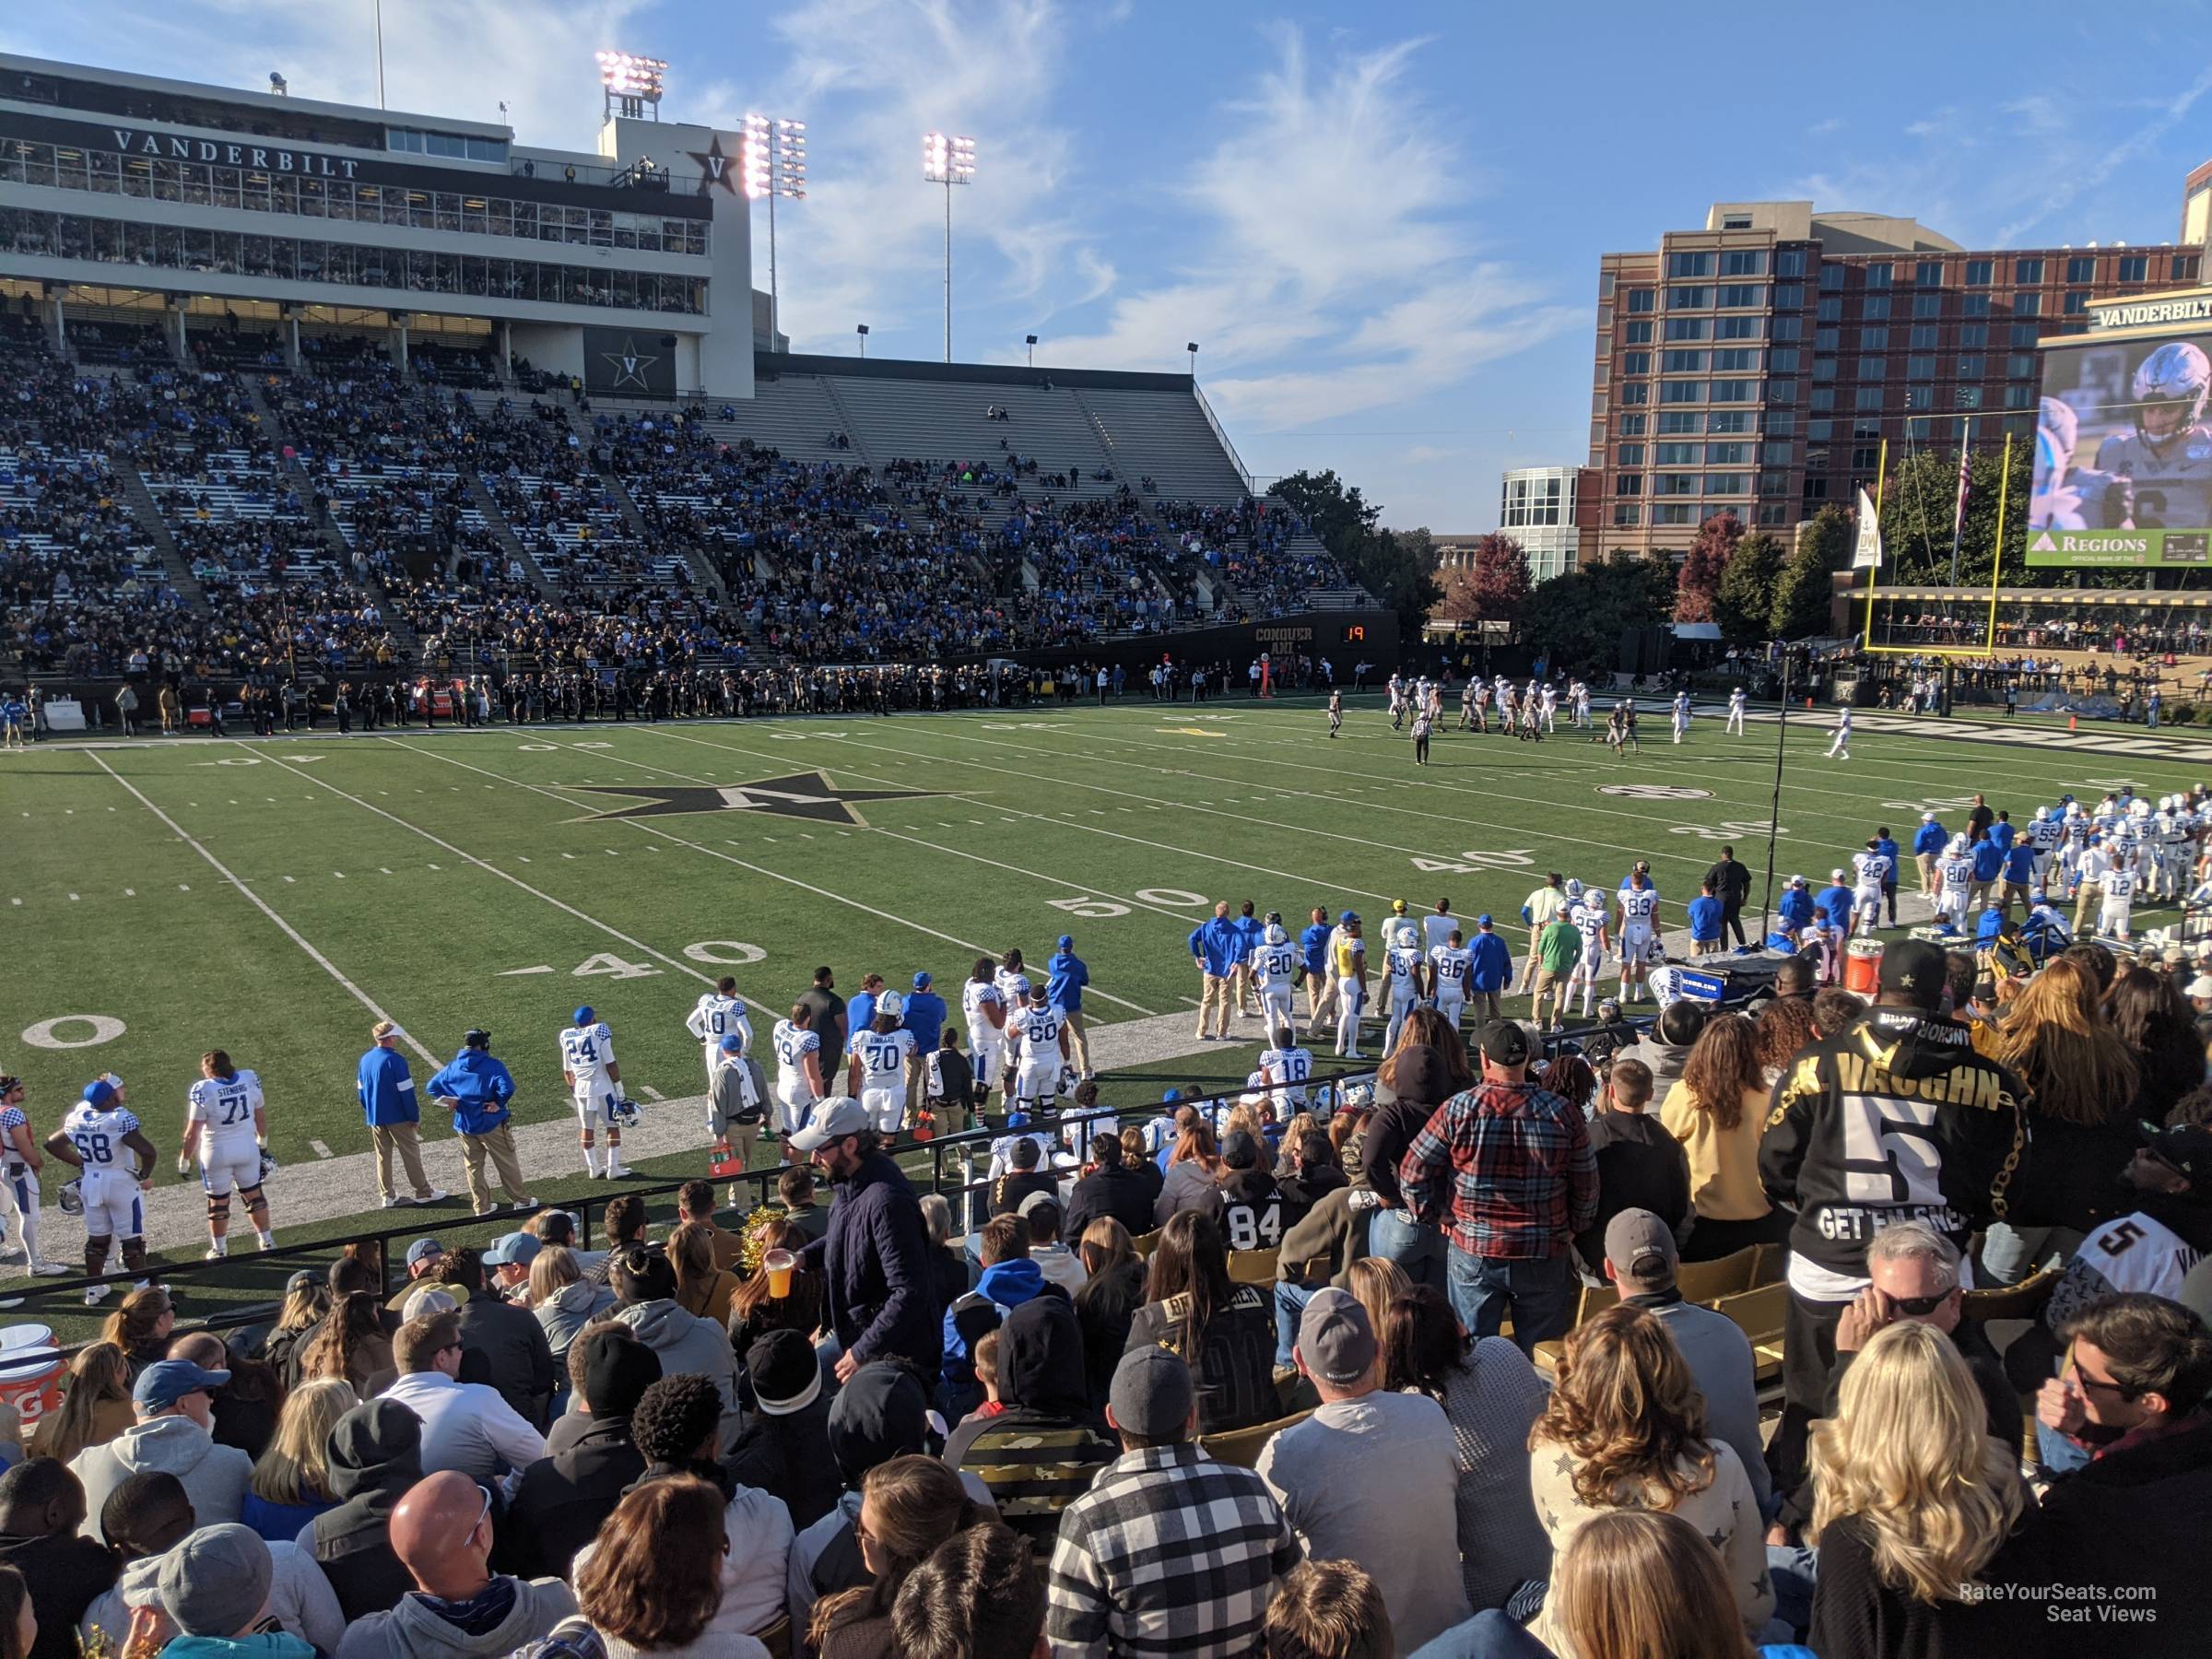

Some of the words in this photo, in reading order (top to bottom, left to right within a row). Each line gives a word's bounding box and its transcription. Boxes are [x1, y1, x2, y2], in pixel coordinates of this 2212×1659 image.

[113, 130, 359, 179] VANDERBILT
[708, 157, 724, 179] V
[2100, 300, 2212, 327] VANDERBILT
[623, 357, 637, 374] V
[1255, 627, 1312, 641] CONQUER
[1348, 627, 1363, 640] 19
[2039, 828, 2056, 841] 55
[1862, 862, 1883, 878] 42
[1947, 866, 1968, 883] 80
[2110, 880, 2131, 895] 12
[1628, 898, 1652, 915] 83
[1268, 953, 1292, 975] 20
[1439, 957, 1465, 979] 86
[704, 1008, 725, 1034] 10
[1029, 1023, 1057, 1043] 60
[566, 1035, 598, 1065] 24
[866, 1045, 900, 1071] 70
[1282, 1059, 1307, 1080] 18
[218, 1094, 251, 1125] 71
[1843, 1096, 1947, 1206] 5
[1228, 1203, 1282, 1251] 84
[1818, 1207, 1865, 1240] GET
[2098, 1220, 2147, 1257] 5
[14, 1389, 43, 1418] G
